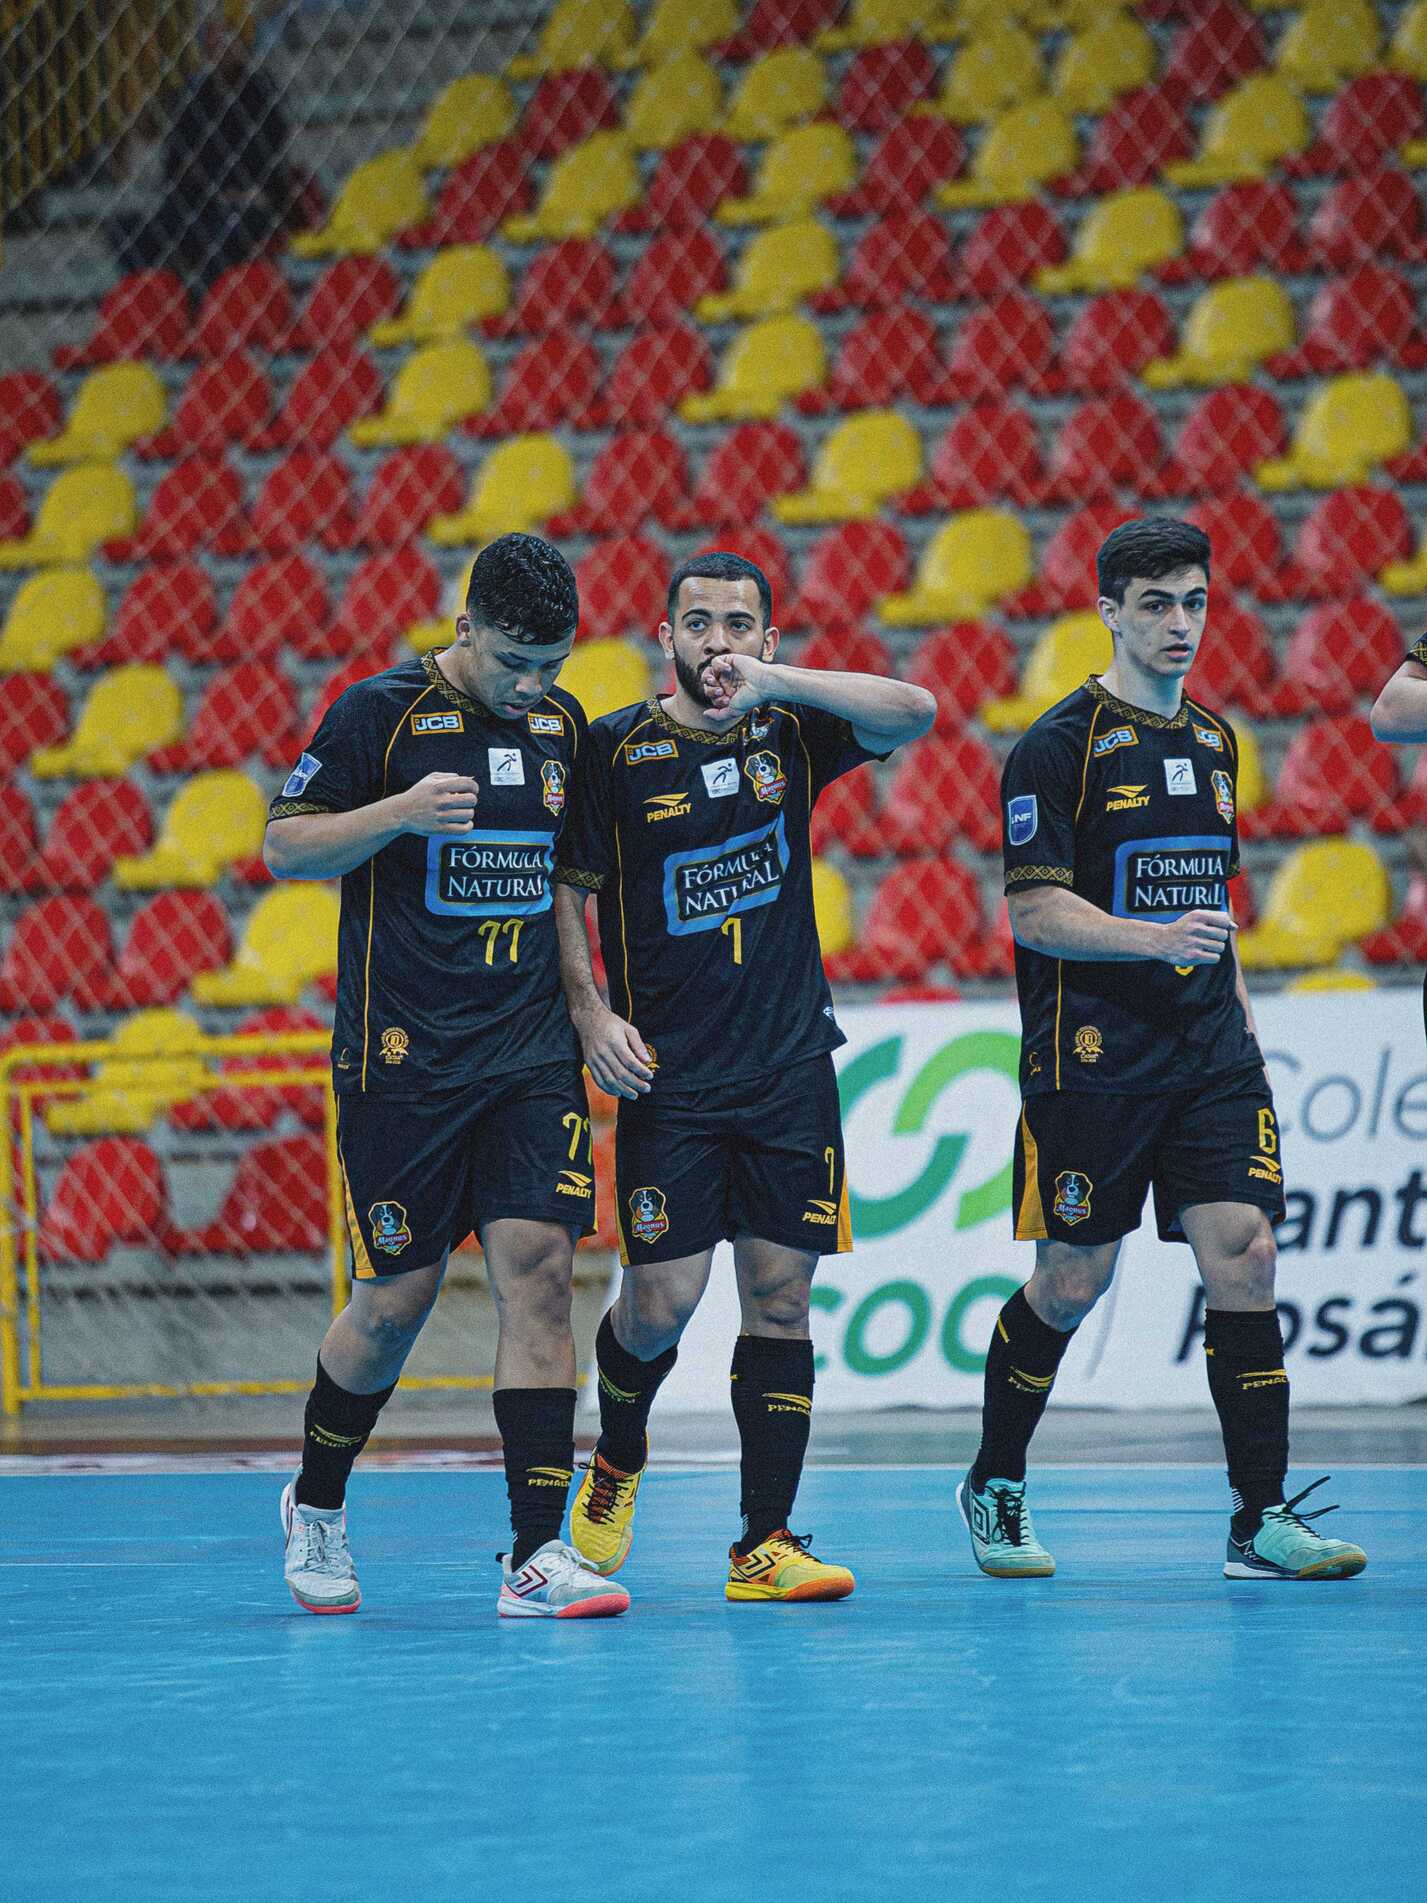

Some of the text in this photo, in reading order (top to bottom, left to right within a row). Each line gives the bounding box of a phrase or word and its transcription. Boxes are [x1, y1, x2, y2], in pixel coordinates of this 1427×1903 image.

[415, 715, 459, 731] JCB
[530, 717, 561, 731] JCB
[629, 743, 673, 760] JCB
[1094, 730, 1133, 753] JCB
[647, 803, 692, 823] PENALTY
[1105, 796, 1151, 811] PENALTY
[449, 846, 543, 869] FÓRMULA
[1136, 854, 1224, 878] FÓRMULA
[478, 918, 524, 966] 77
[1257, 1108, 1277, 1154] 6
[802, 1211, 837, 1225] PENAL
